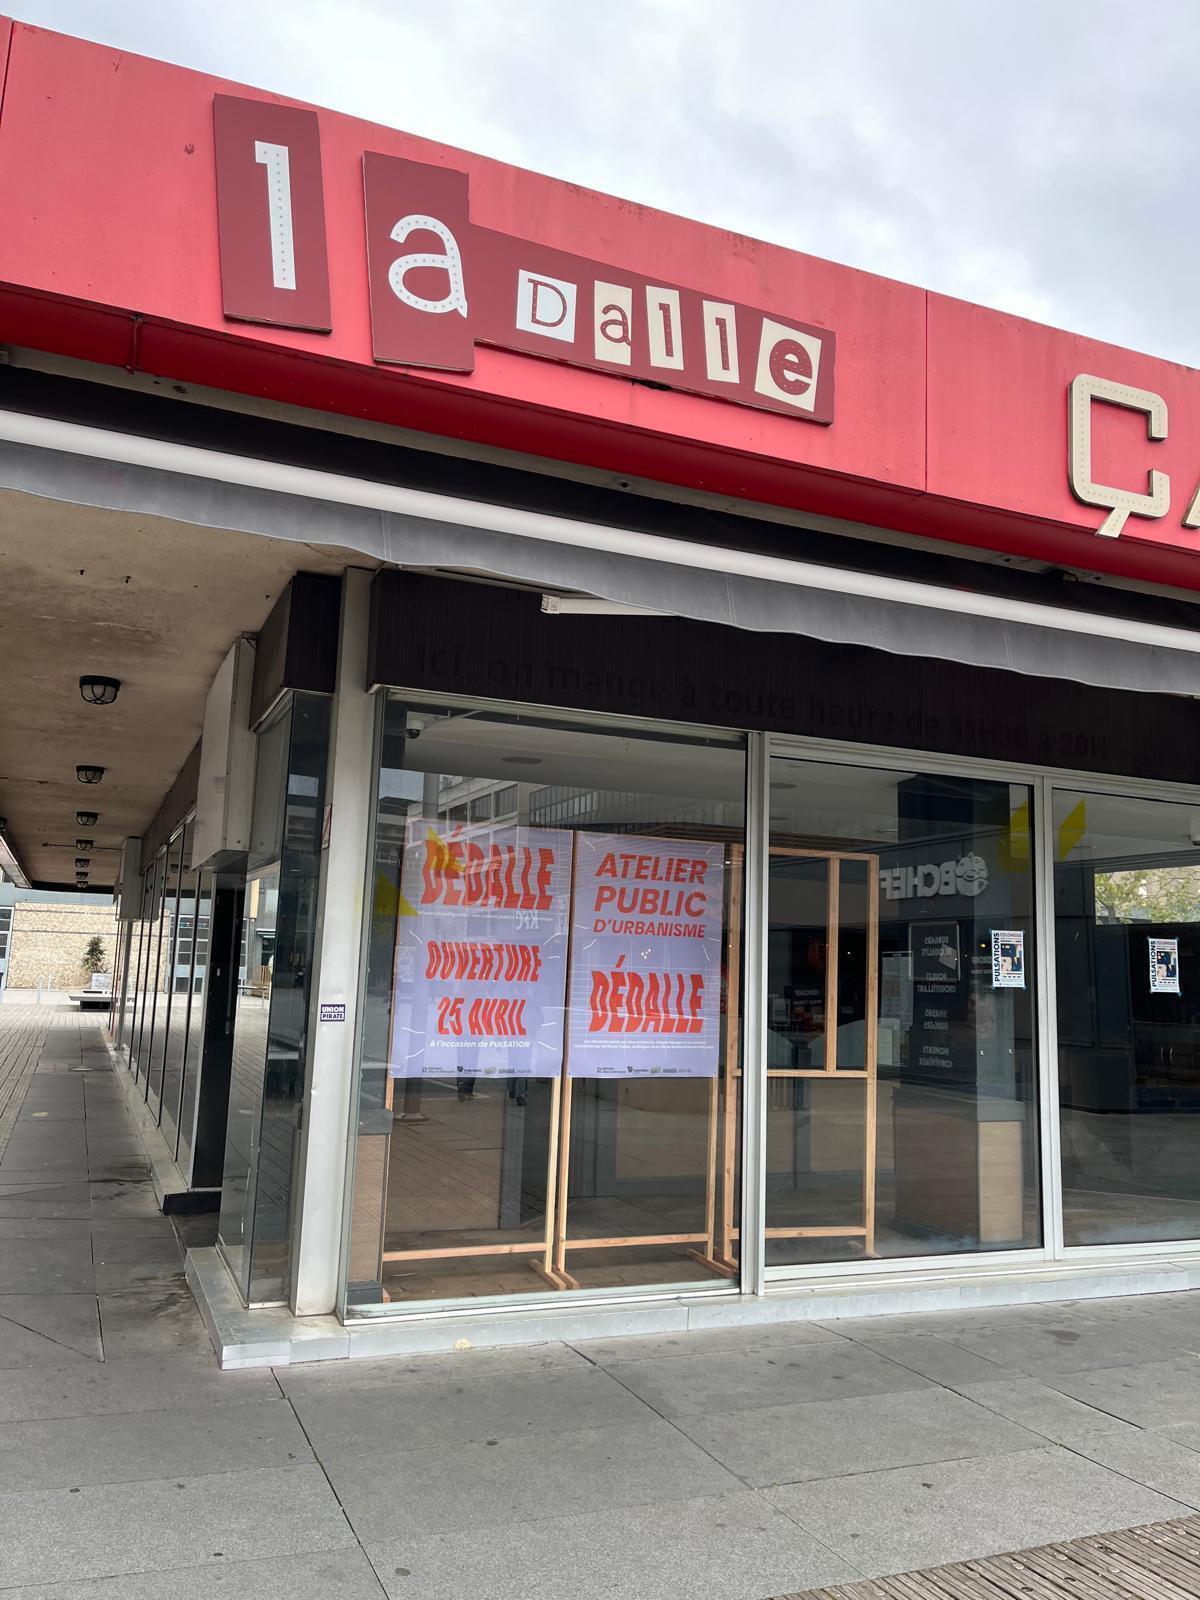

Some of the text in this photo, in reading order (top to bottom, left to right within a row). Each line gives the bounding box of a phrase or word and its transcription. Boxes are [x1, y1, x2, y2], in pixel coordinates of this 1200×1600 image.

[255, 140, 814, 396] la Dalle
[546, 659, 668, 710] mange
[708, 683, 797, 721] toute
[806, 691, 896, 735] heure
[906, 708, 940, 741] de
[594, 852, 708, 885] ATELIER
[594, 885, 708, 918] PUBLIC
[593, 918, 707, 938] D'URBANISME
[425, 940, 542, 982] OUVERTURE
[993, 932, 1001, 982] PULSATIONS
[588, 954, 705, 1033] DÉDALLE
[437, 996, 527, 1036] 25 AVRIL
[477, 1040, 488, 1048] de
